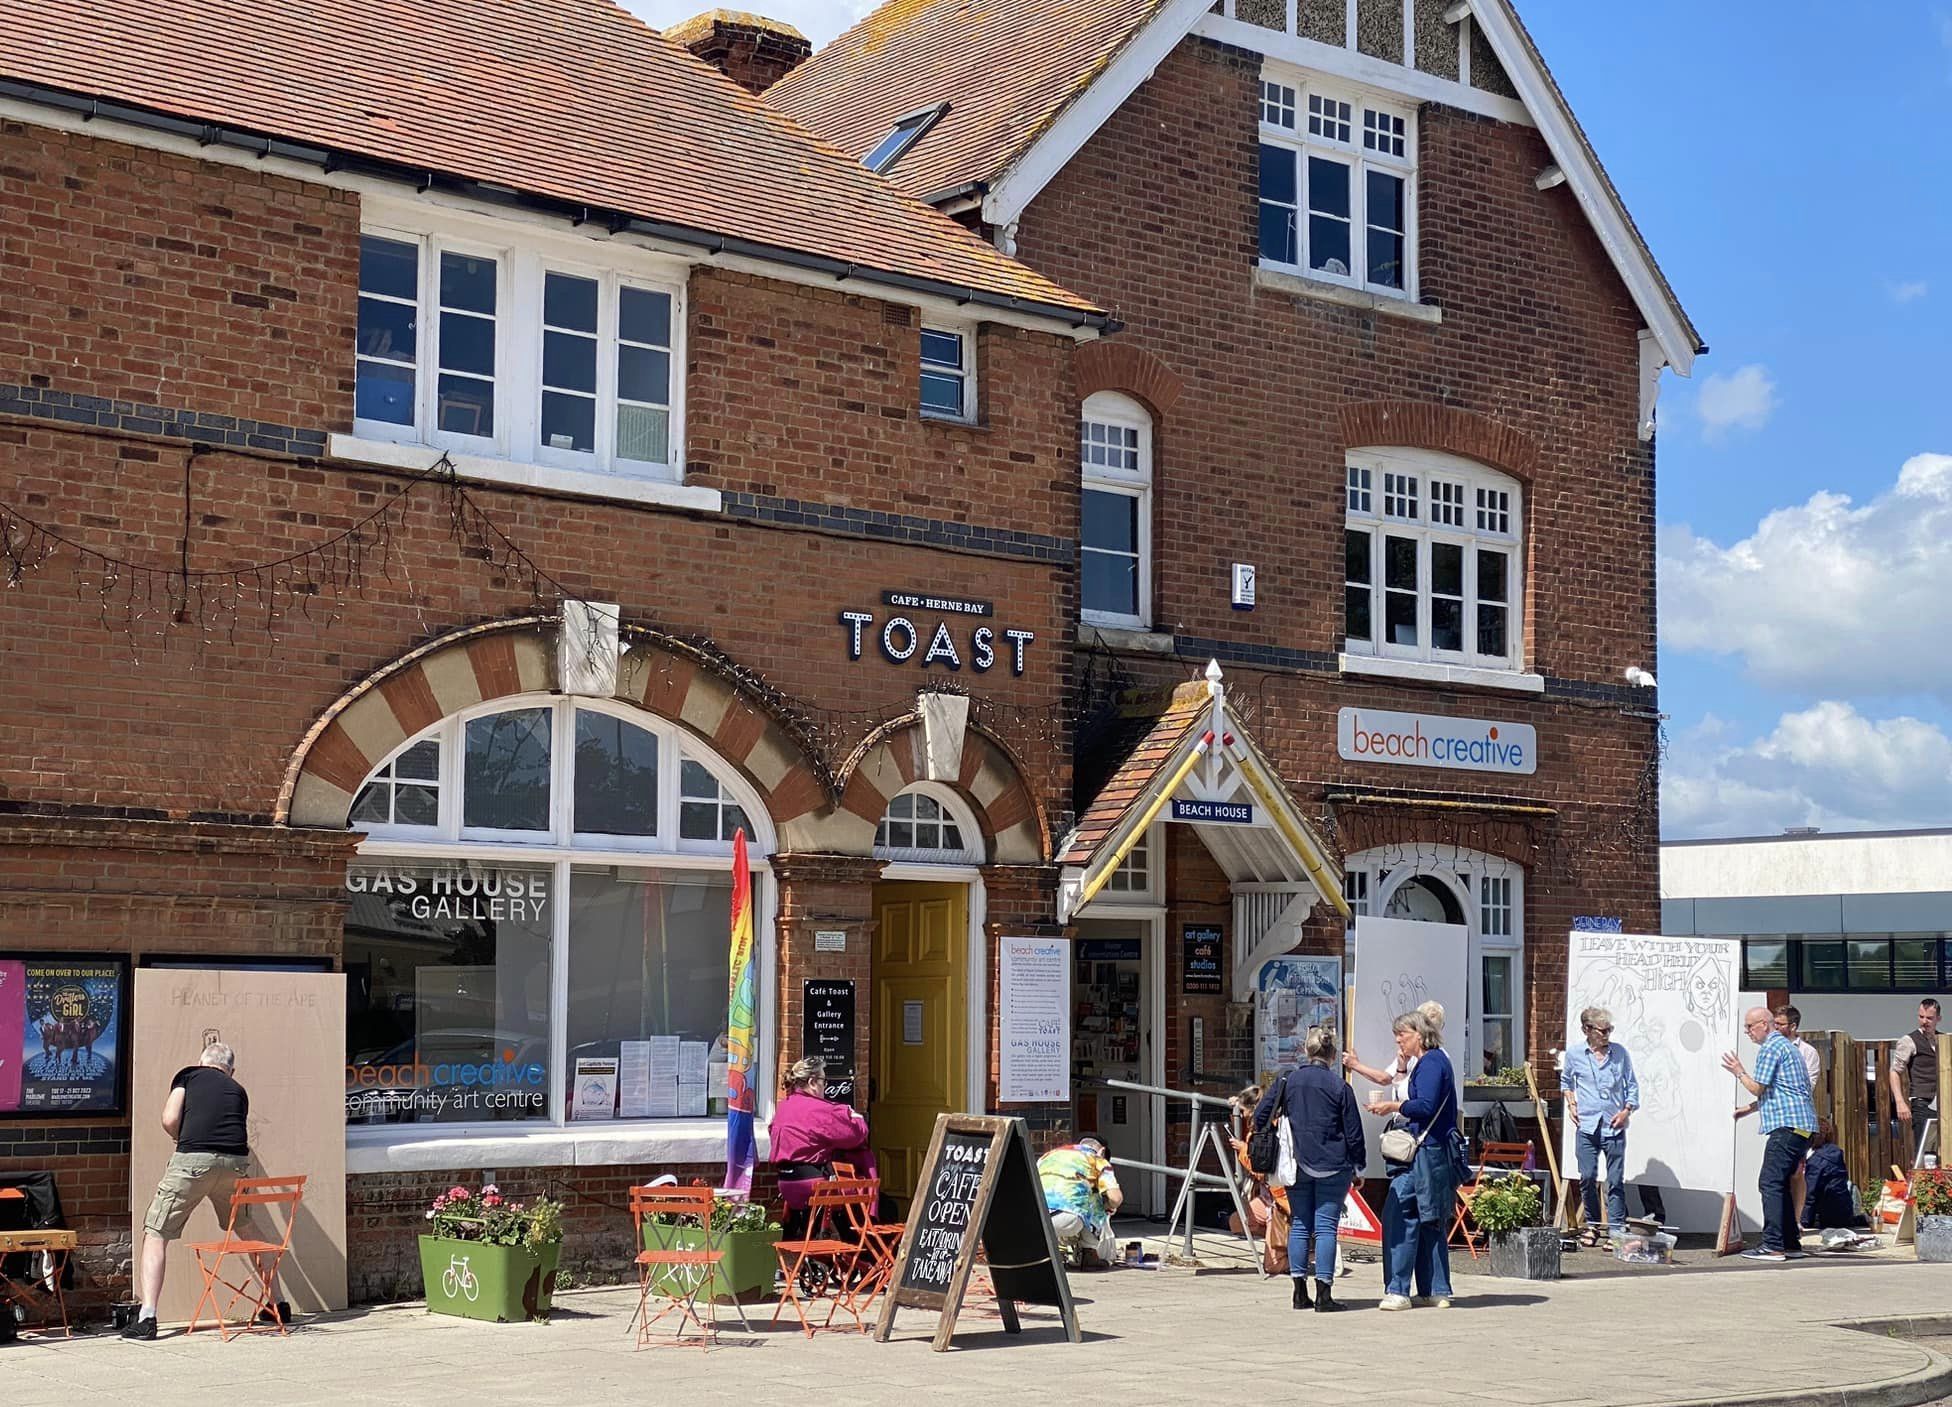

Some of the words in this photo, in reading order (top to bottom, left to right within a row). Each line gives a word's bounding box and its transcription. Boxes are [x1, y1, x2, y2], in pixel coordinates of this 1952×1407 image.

[891, 594, 919, 607] CAFE
[926, 598, 962, 612] HERNE
[963, 602, 985, 614] BAY
[841, 611, 1034, 675] TOAST
[1353, 714, 1428, 759] beach
[1432, 727, 1523, 766] creative
[1179, 803, 1211, 816] BEACH
[1215, 806, 1248, 818] HOUSE
[345, 868, 417, 894] GAS
[432, 869, 547, 898] HOUSE
[411, 895, 546, 921] GALLERY
[1185, 930, 1196, 939] art
[1197, 928, 1221, 942] gallery
[1194, 944, 1212, 956] café
[1580, 937, 1626, 951] LEAVE
[1630, 939, 1682, 953] WITH
[1684, 942, 1730, 954] YOUR
[1190, 959, 1216, 970] studios
[1615, 952, 1662, 966] HEAD
[26, 969, 45, 977] COME
[45, 969, 55, 977] ON
[55, 969, 72, 977] OVER
[72, 969, 81, 977] TO
[81, 969, 94, 977] OUR
[94, 969, 116, 977] PLACE!
[810, 987, 827, 995] Café
[828, 987, 848, 995] Toast
[817, 1010, 842, 1019] Gallery
[433, 1049, 545, 1087] creative
[824, 1081, 853, 1098] afé
[453, 1090, 479, 1109] art
[484, 1090, 544, 1108] centre
[945, 1144, 992, 1163] TOAST
[935, 1171, 984, 1201] CAFE
[928, 1200, 971, 1226] OPEN
[912, 1257, 957, 1285] TAKEAWA
